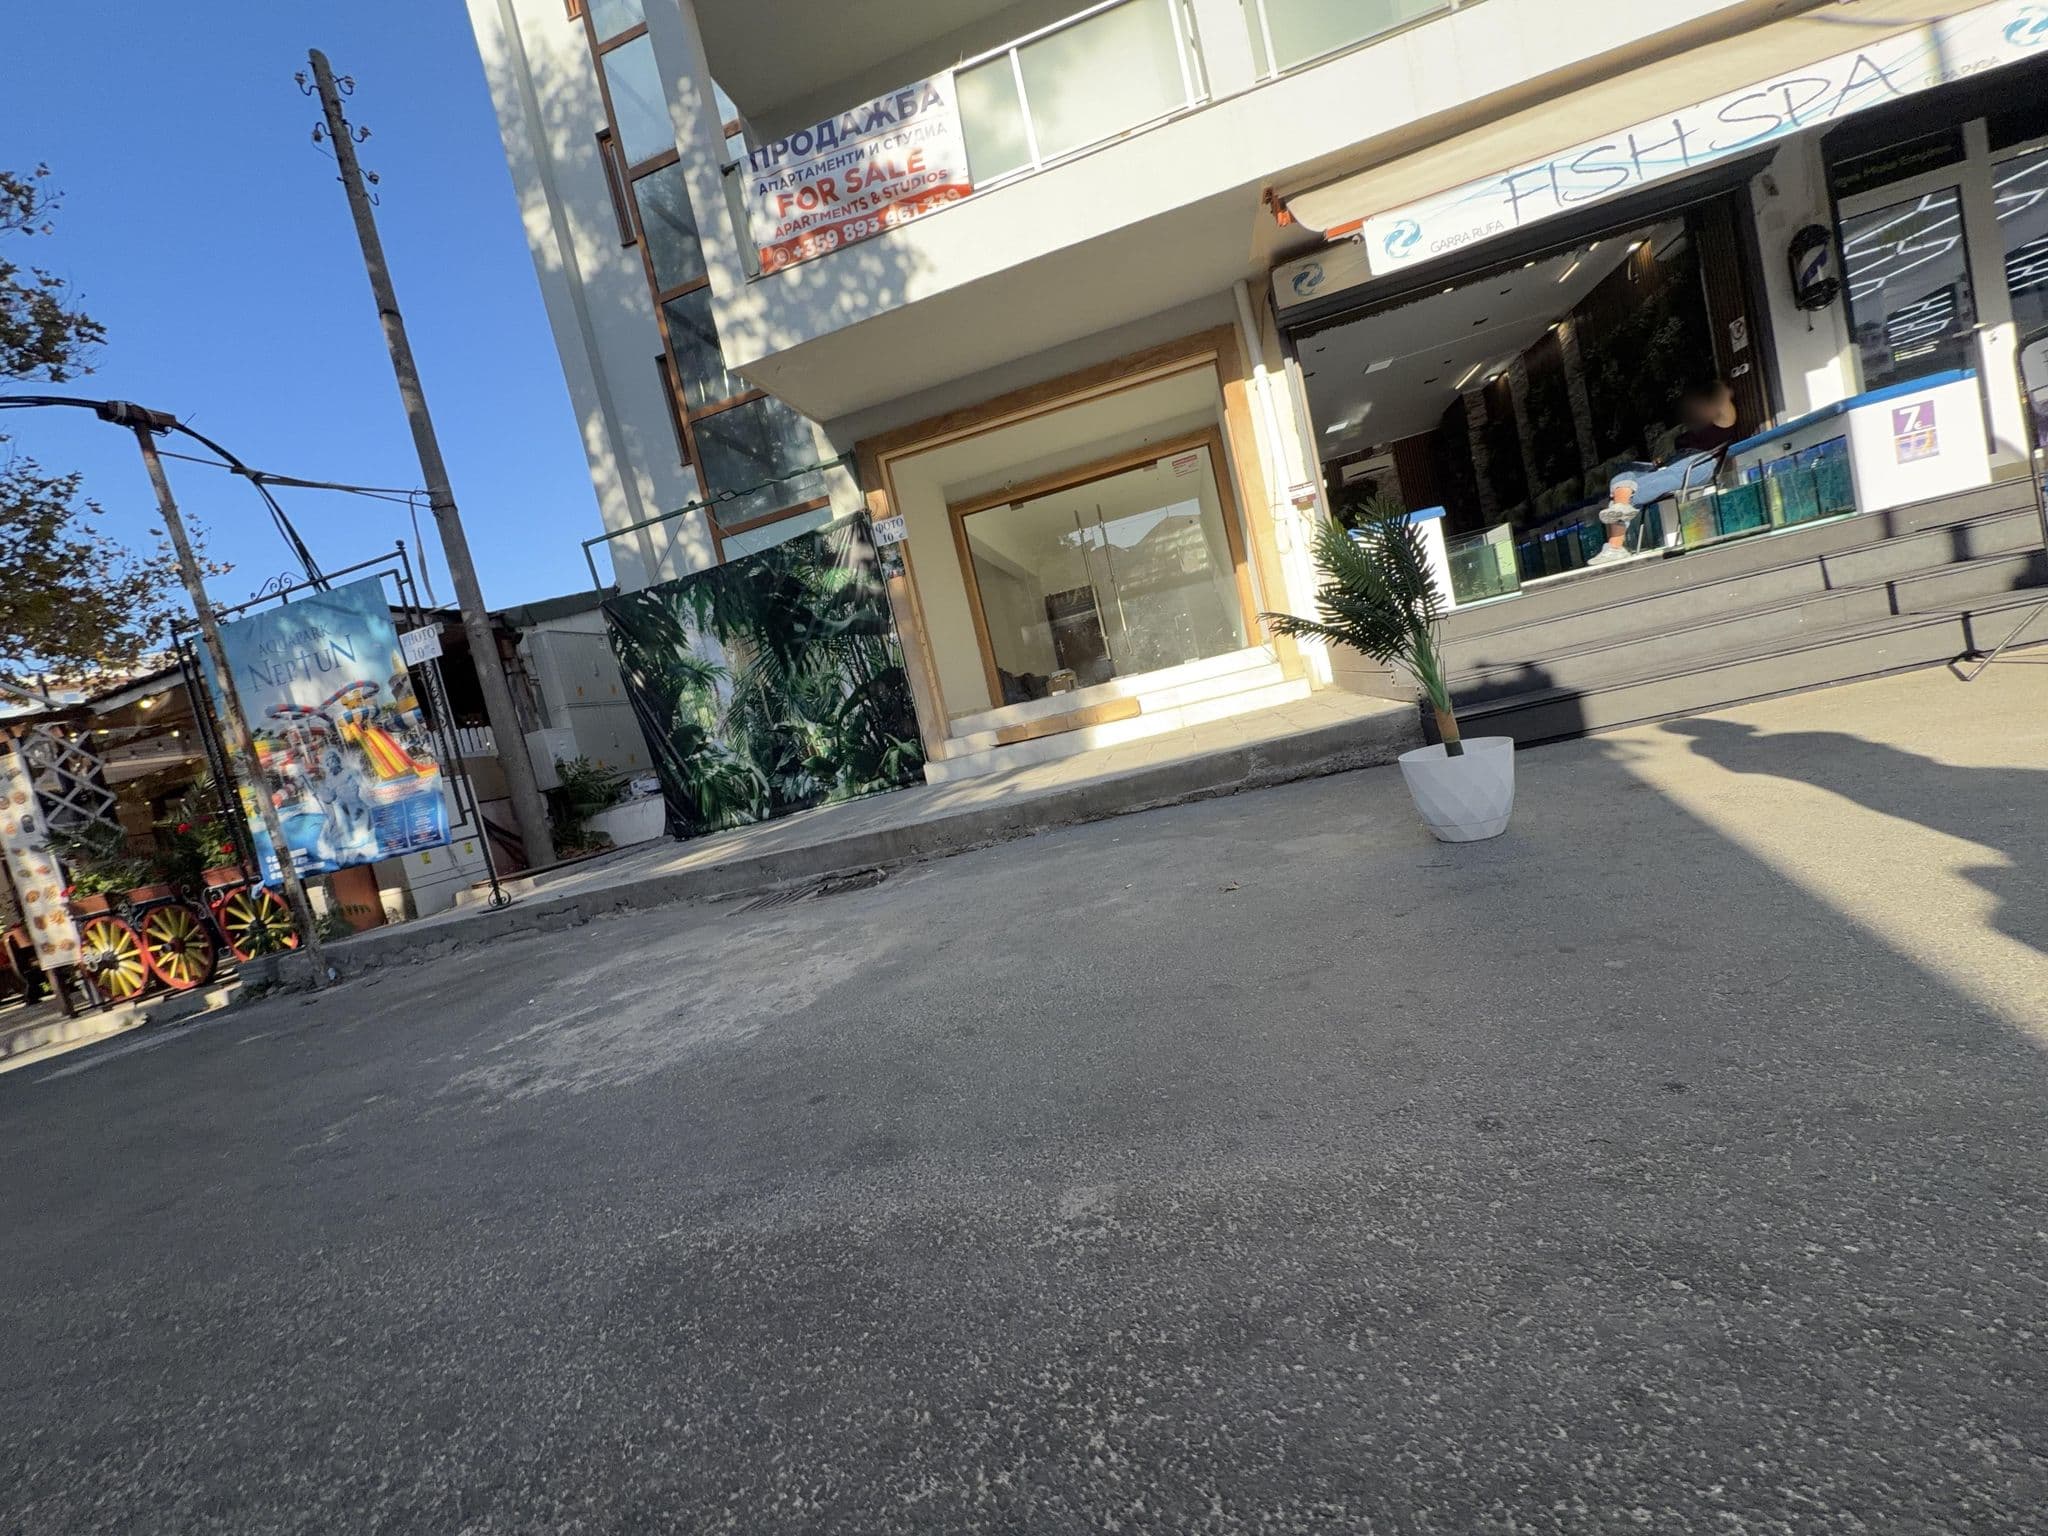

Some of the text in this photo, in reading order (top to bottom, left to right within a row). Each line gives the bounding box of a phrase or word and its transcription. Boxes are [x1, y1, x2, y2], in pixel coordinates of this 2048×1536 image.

[750, 83, 945, 173] ПРОДАЖБА
[1500, 53, 1905, 225] FISH SPA
[759, 149, 865, 196] АПАРТАМЕНТИ
[869, 142, 880, 157] И
[775, 147, 927, 219] FOR SALE
[774, 169, 948, 239] APARTMENTS & STUDIOS
[842, 217, 880, 242] 893
[1430, 219, 1504, 253] GARRA RUFA
[875, 518, 904, 534] ФОТО
[247, 633, 357, 693] NEPTUN
